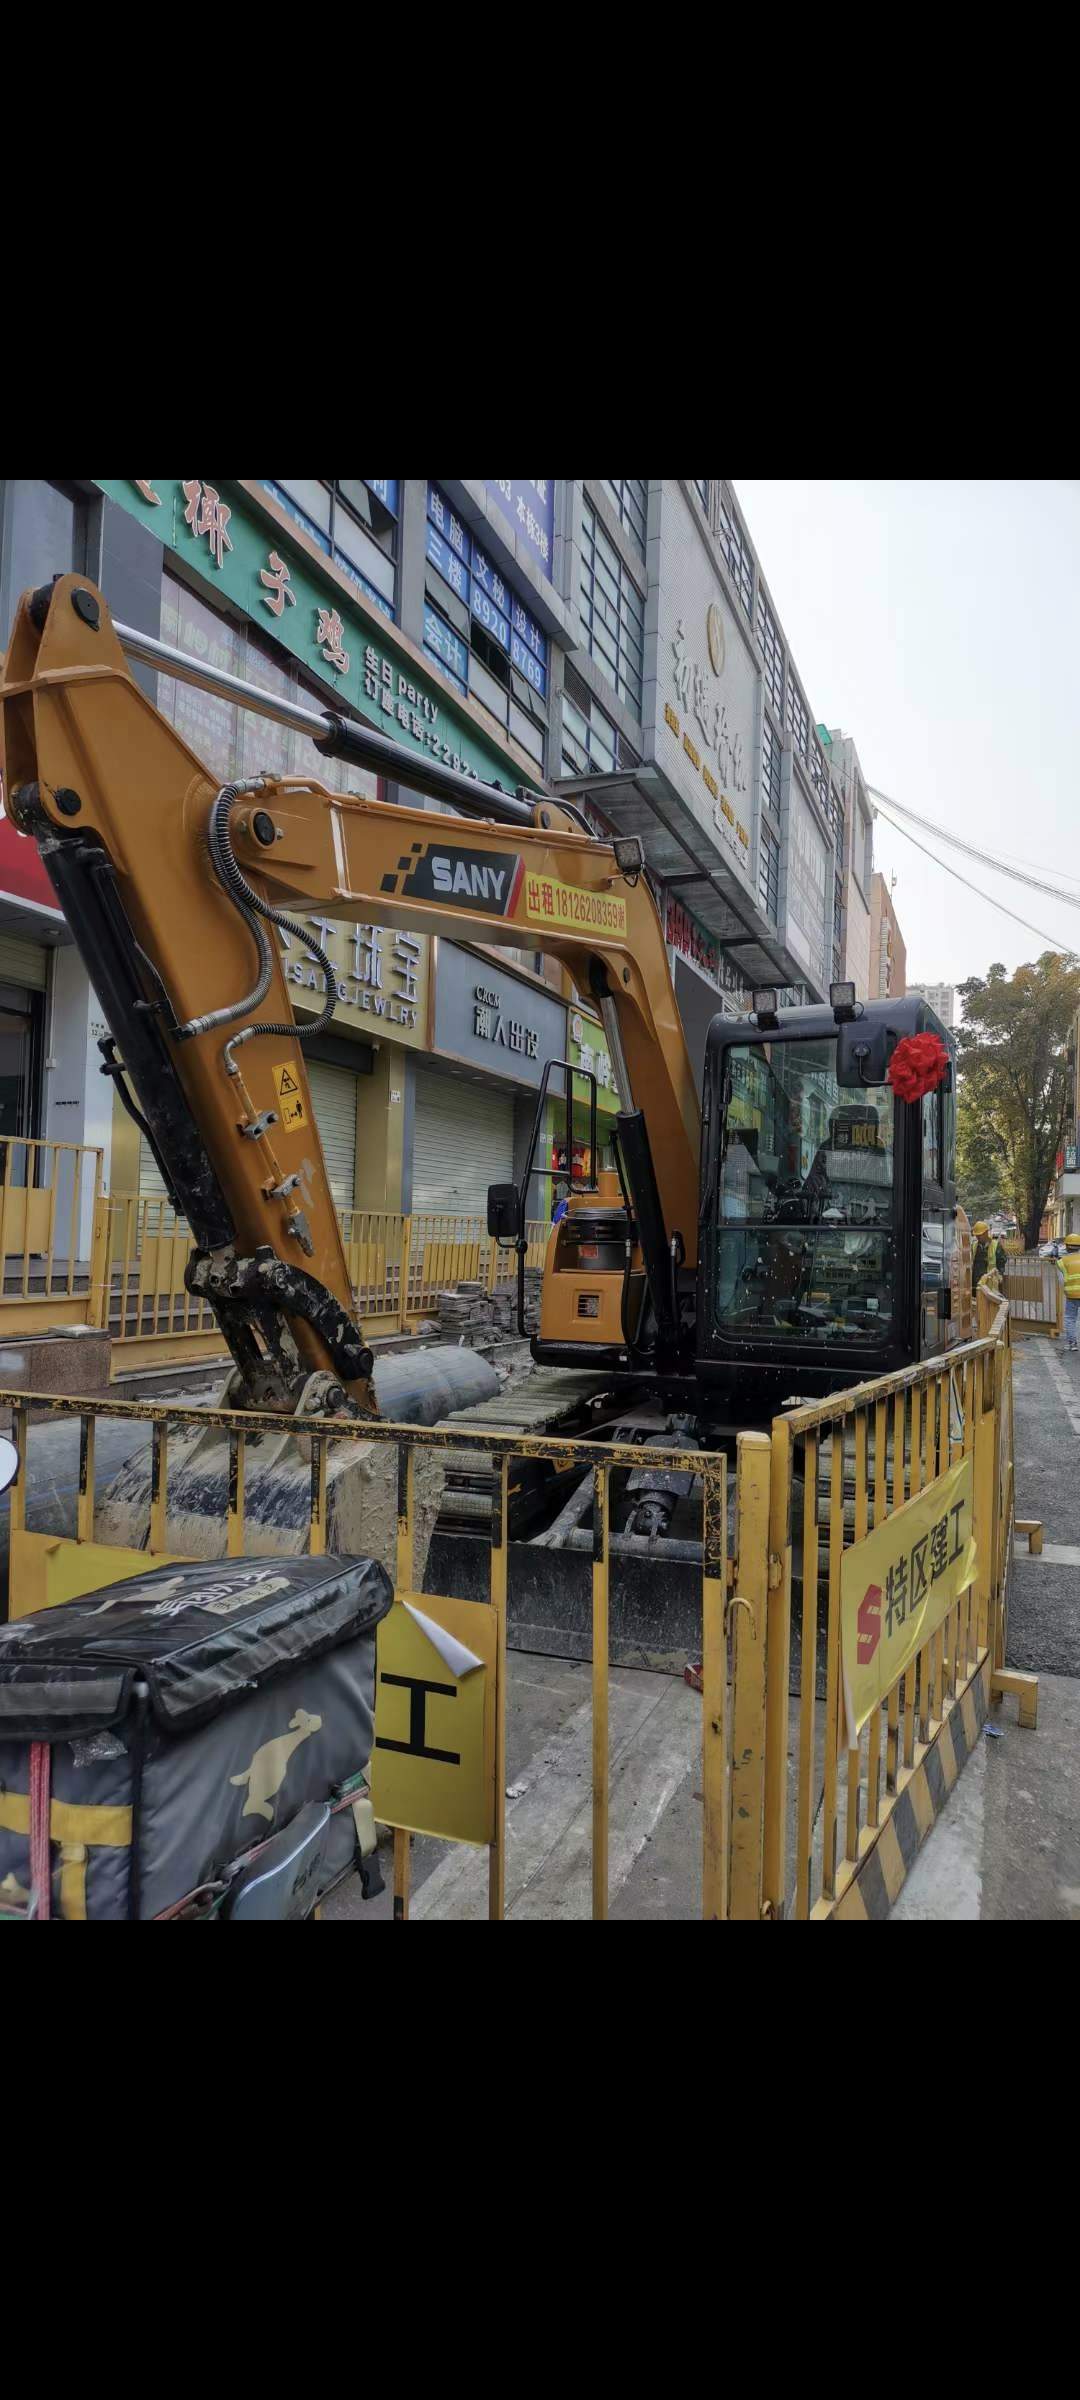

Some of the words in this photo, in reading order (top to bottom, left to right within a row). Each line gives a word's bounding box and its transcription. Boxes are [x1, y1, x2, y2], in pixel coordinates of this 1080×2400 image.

[425, 614, 461, 674] 会计
[428, 530, 462, 592] 三楼
[474, 591, 506, 644] 8920
[513, 640, 541, 687] 8769
[432, 856, 505, 900] SANY
[885, 1499, 965, 1638] 特区建工
